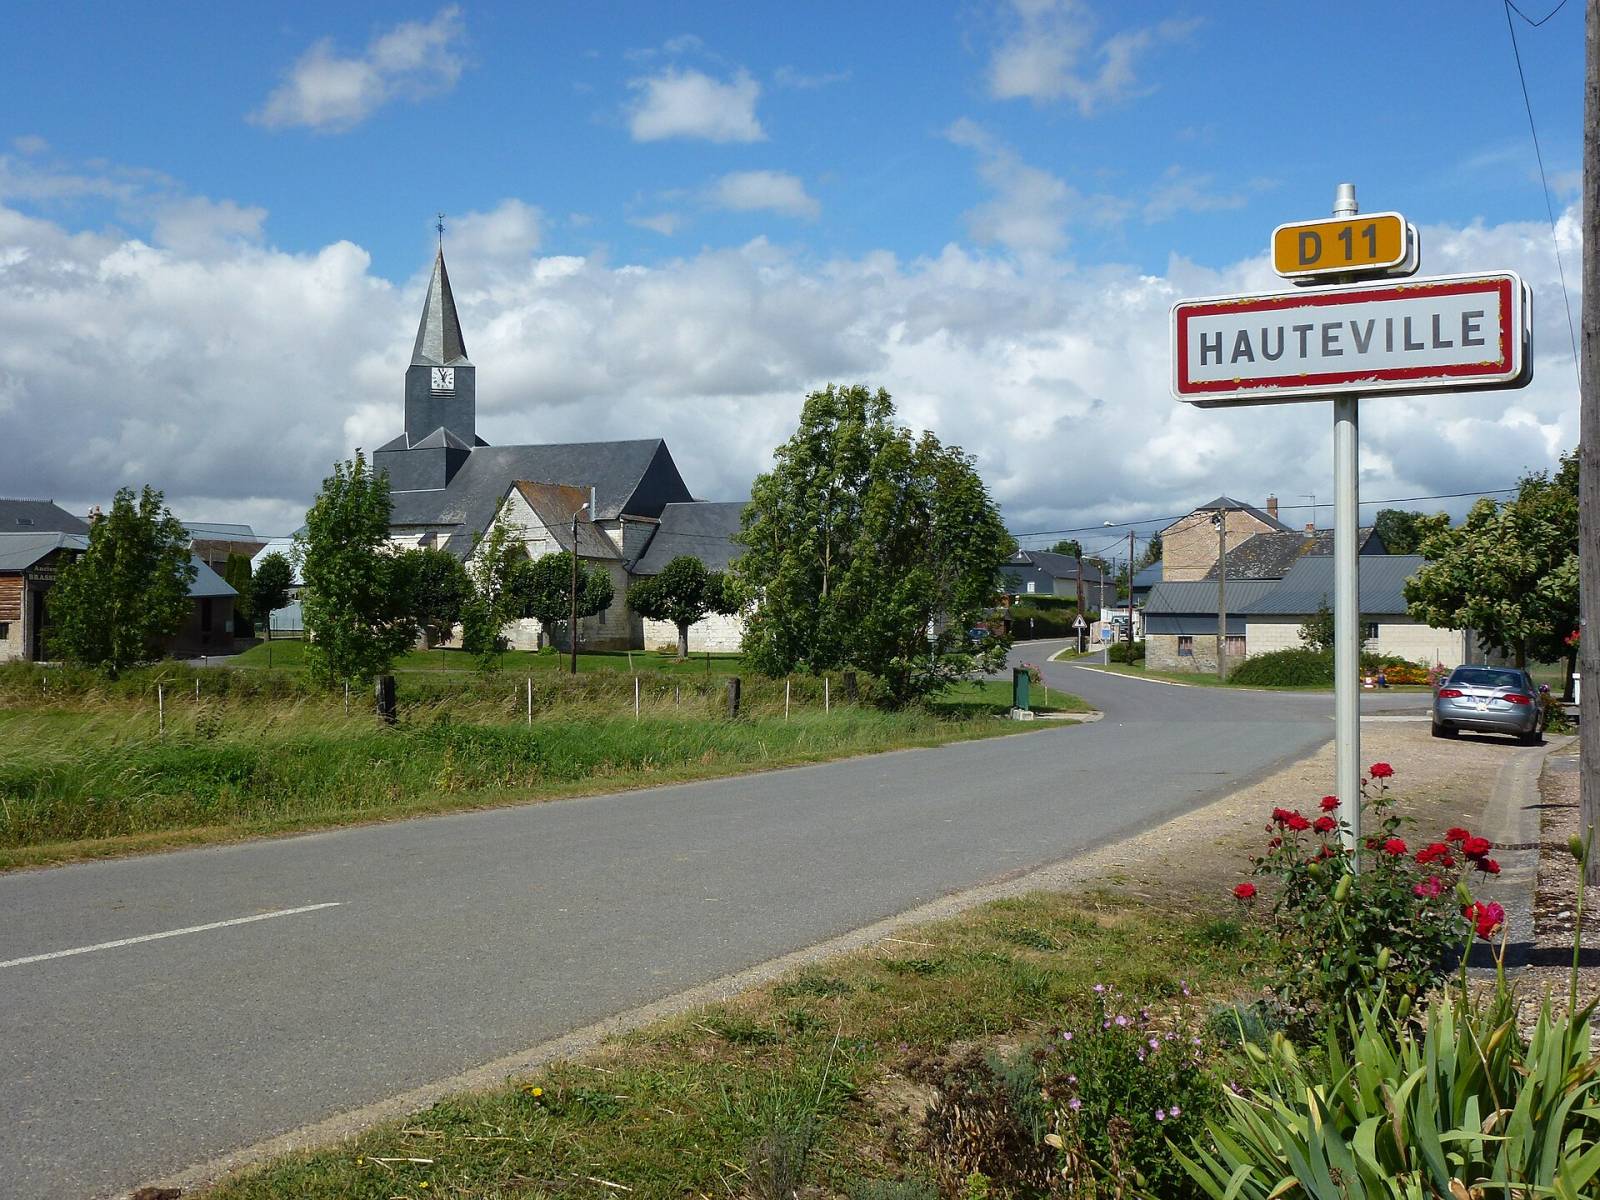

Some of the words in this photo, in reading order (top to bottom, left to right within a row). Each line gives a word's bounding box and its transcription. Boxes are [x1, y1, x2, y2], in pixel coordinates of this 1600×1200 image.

[1298, 231, 1322, 266] D
[1338, 223, 1377, 261] 11
[1200, 310, 1485, 366] HAUTEVILLE
